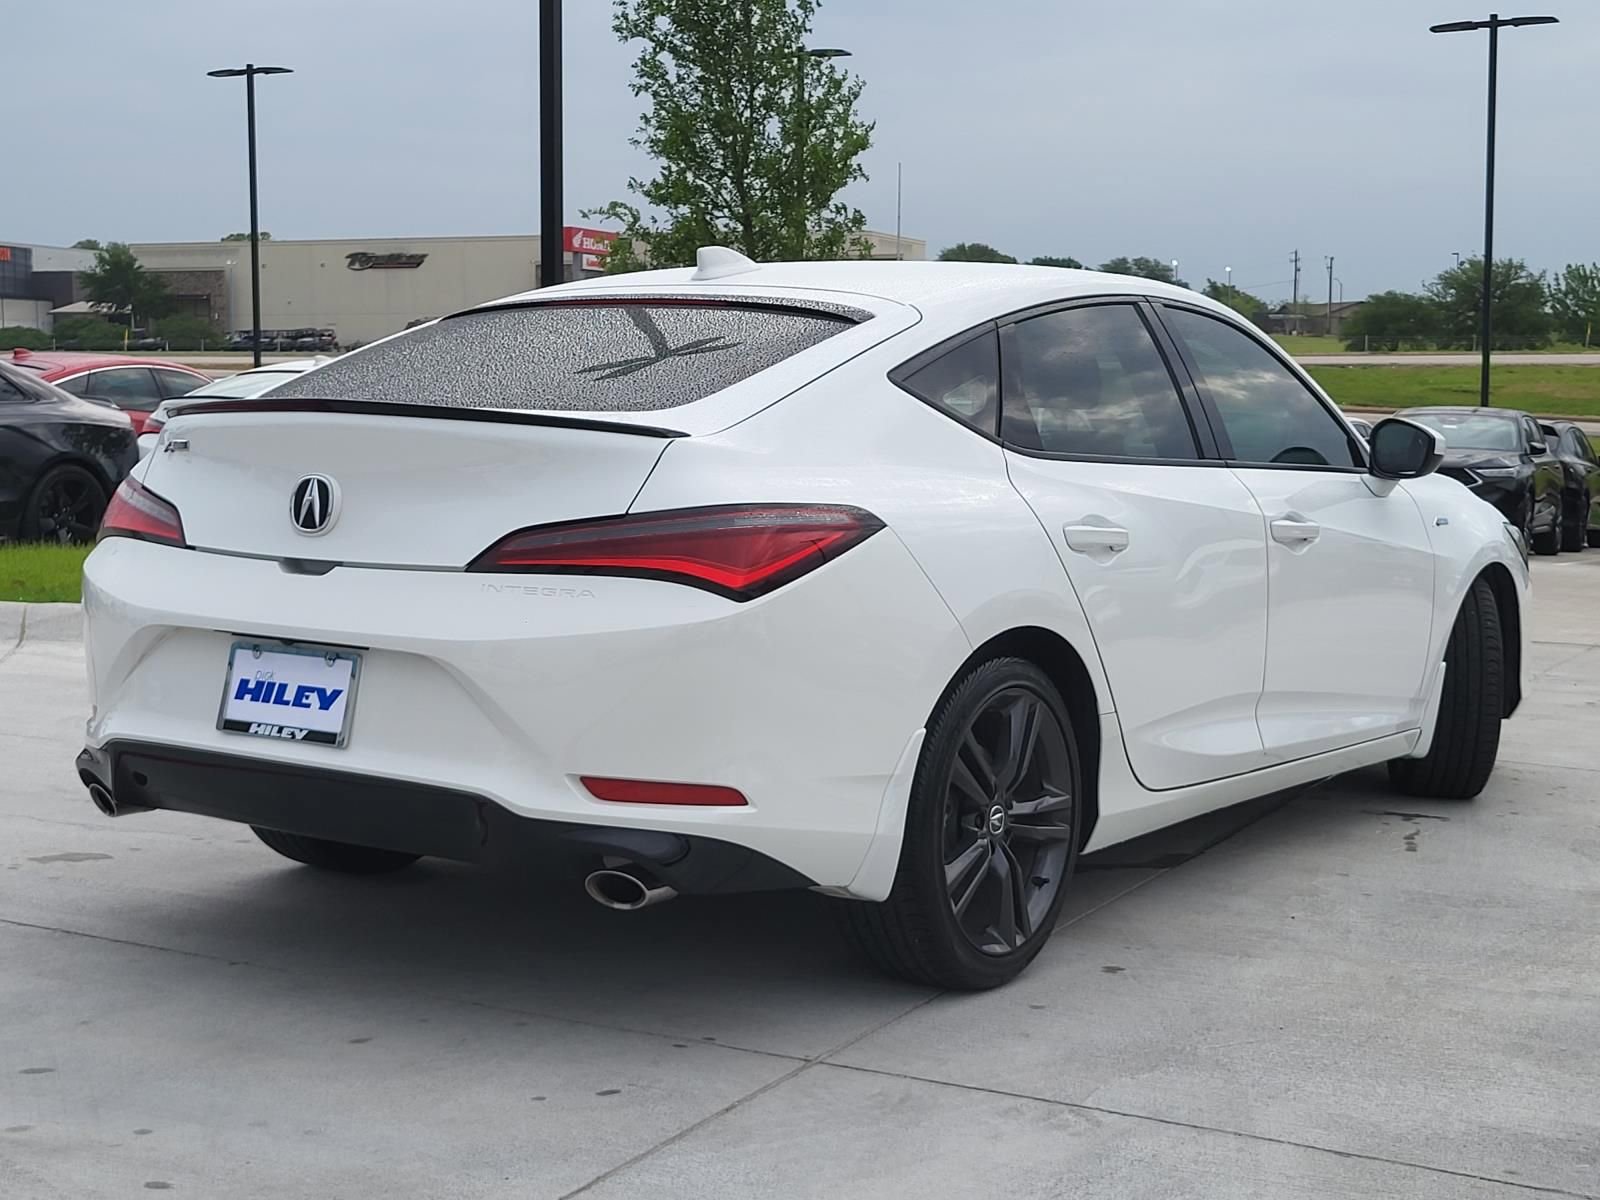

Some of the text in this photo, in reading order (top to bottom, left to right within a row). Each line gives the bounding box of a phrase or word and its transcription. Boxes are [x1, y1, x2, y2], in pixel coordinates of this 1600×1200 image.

[481, 583, 597, 598] INTEGRA
[234, 678, 344, 711] HILEY
[249, 722, 310, 740] HILEY
